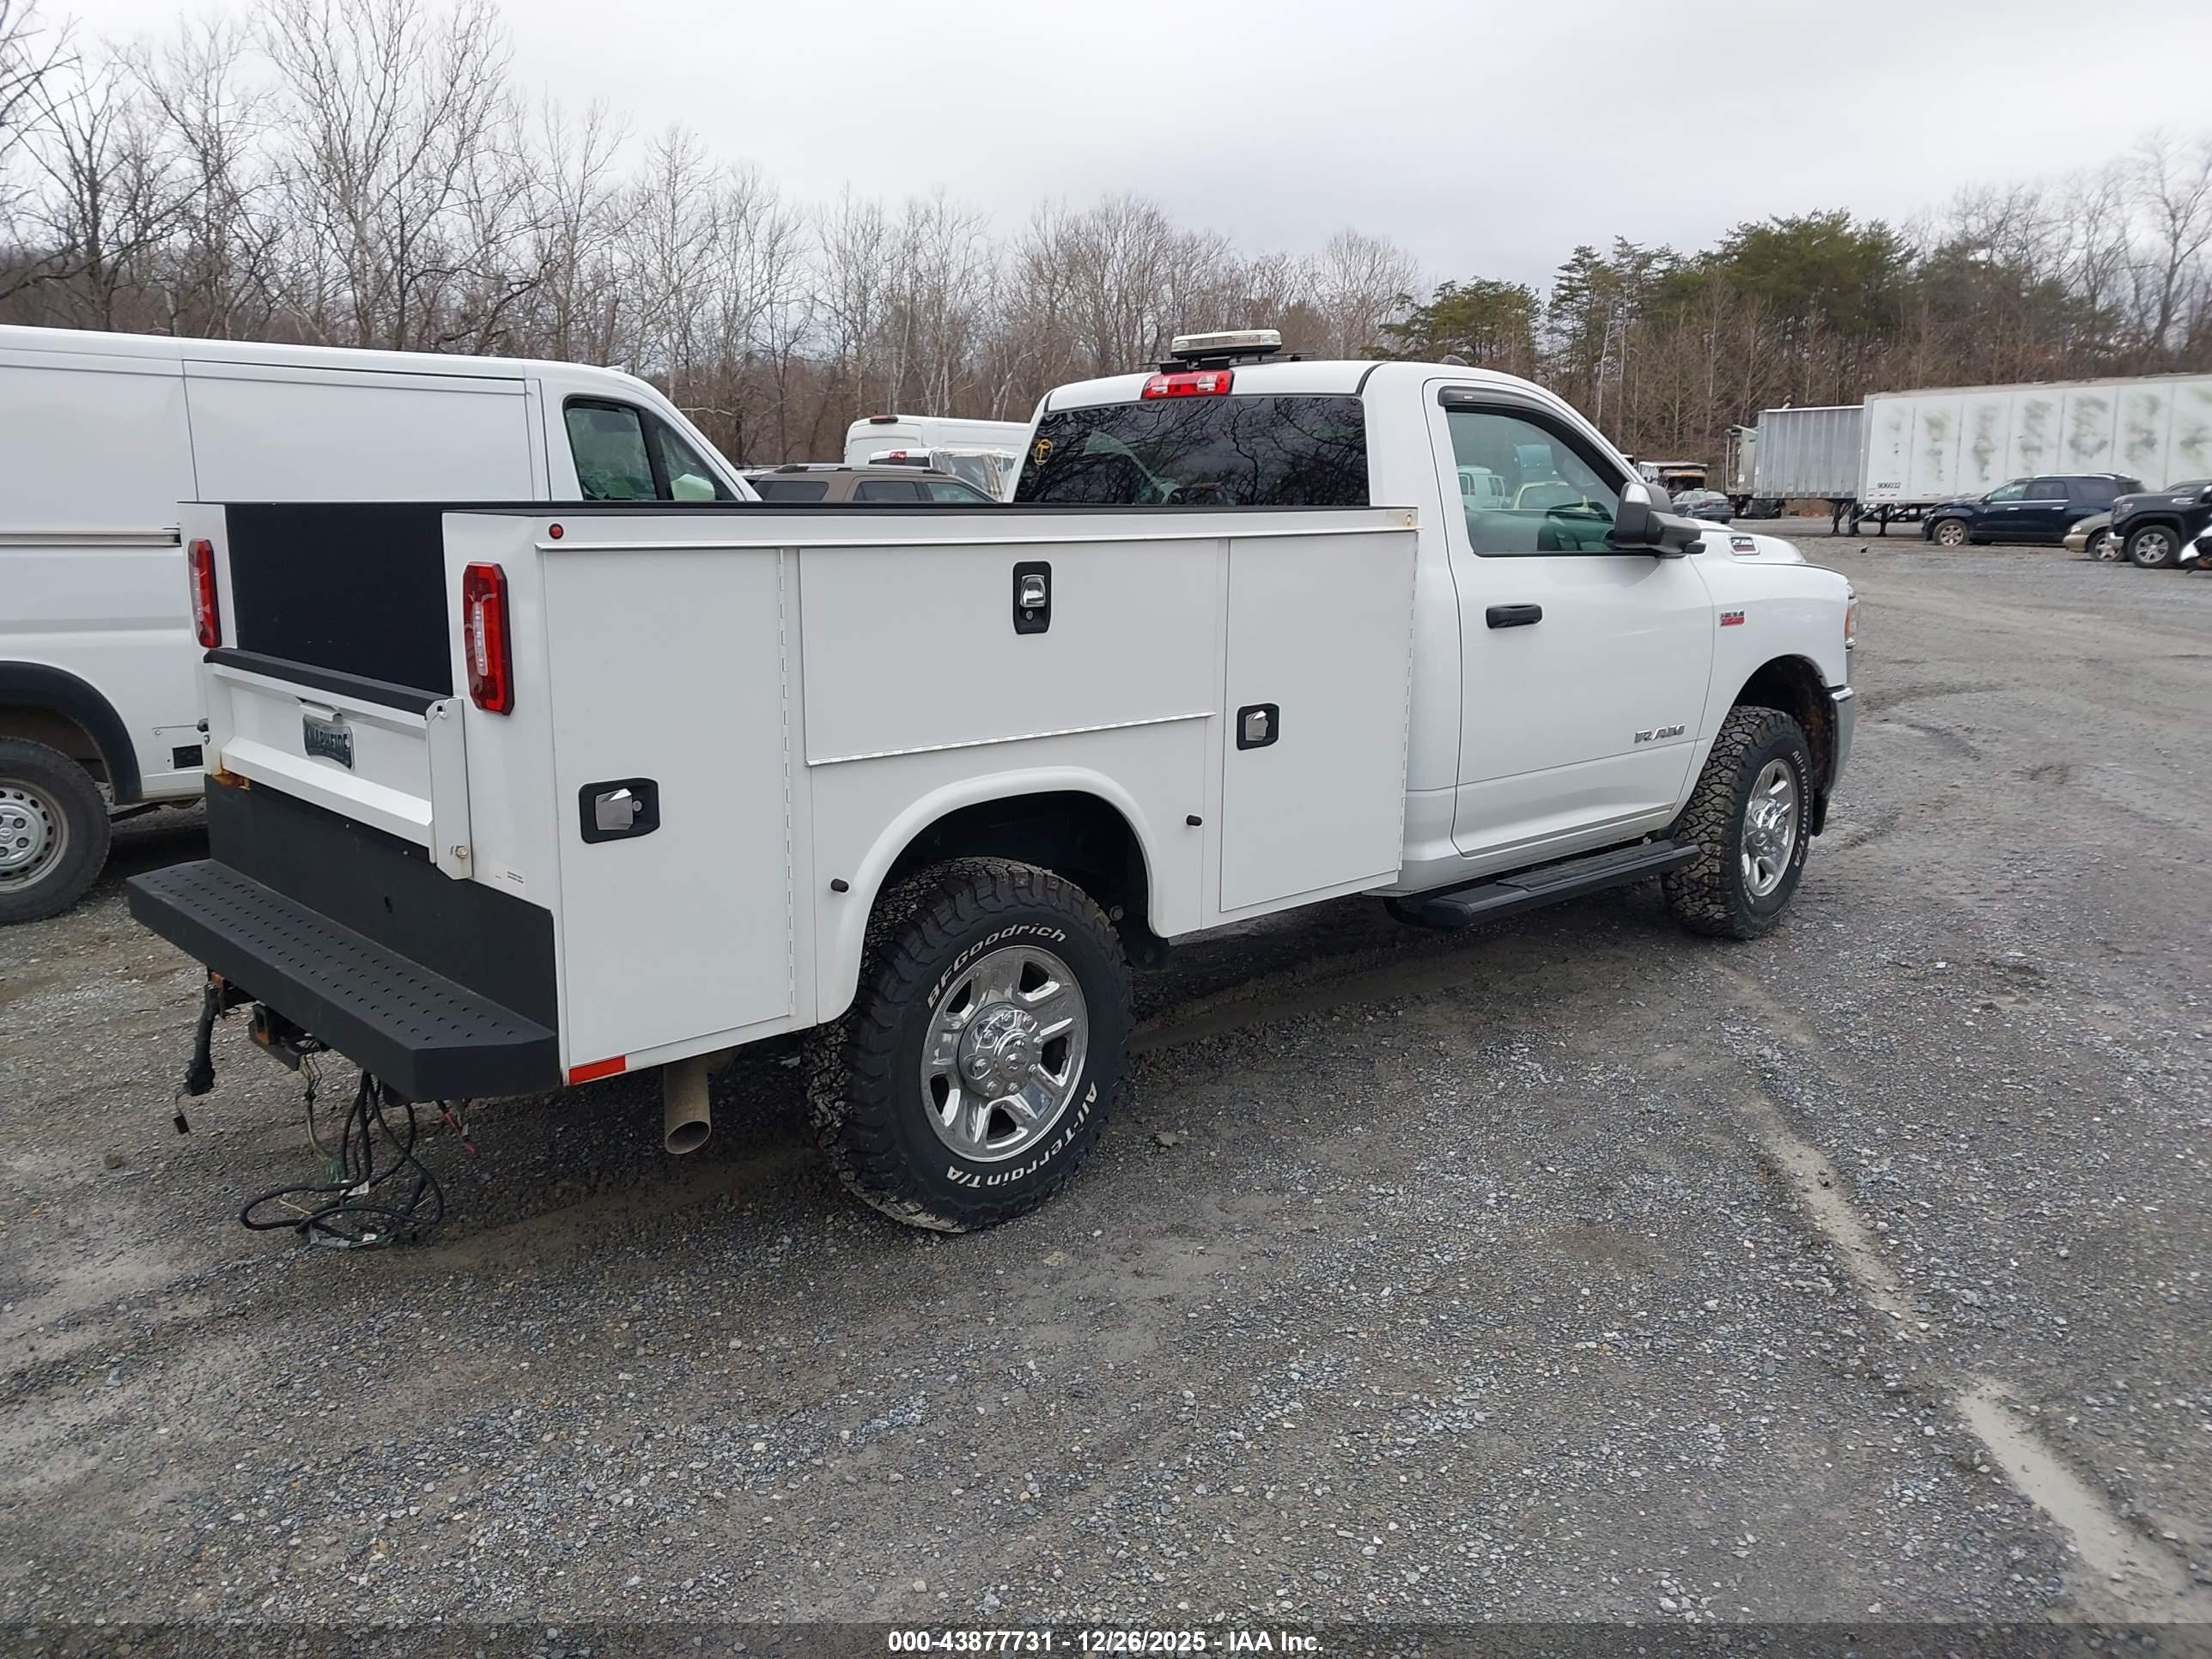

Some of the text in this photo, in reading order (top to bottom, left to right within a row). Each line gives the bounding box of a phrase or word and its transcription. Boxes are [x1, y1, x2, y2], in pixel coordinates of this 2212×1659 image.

[1634, 723, 1686, 744] RAM
[927, 922, 1067, 1010] BFGoodrich
[945, 1080, 1098, 1188] All-Terrain T/A
